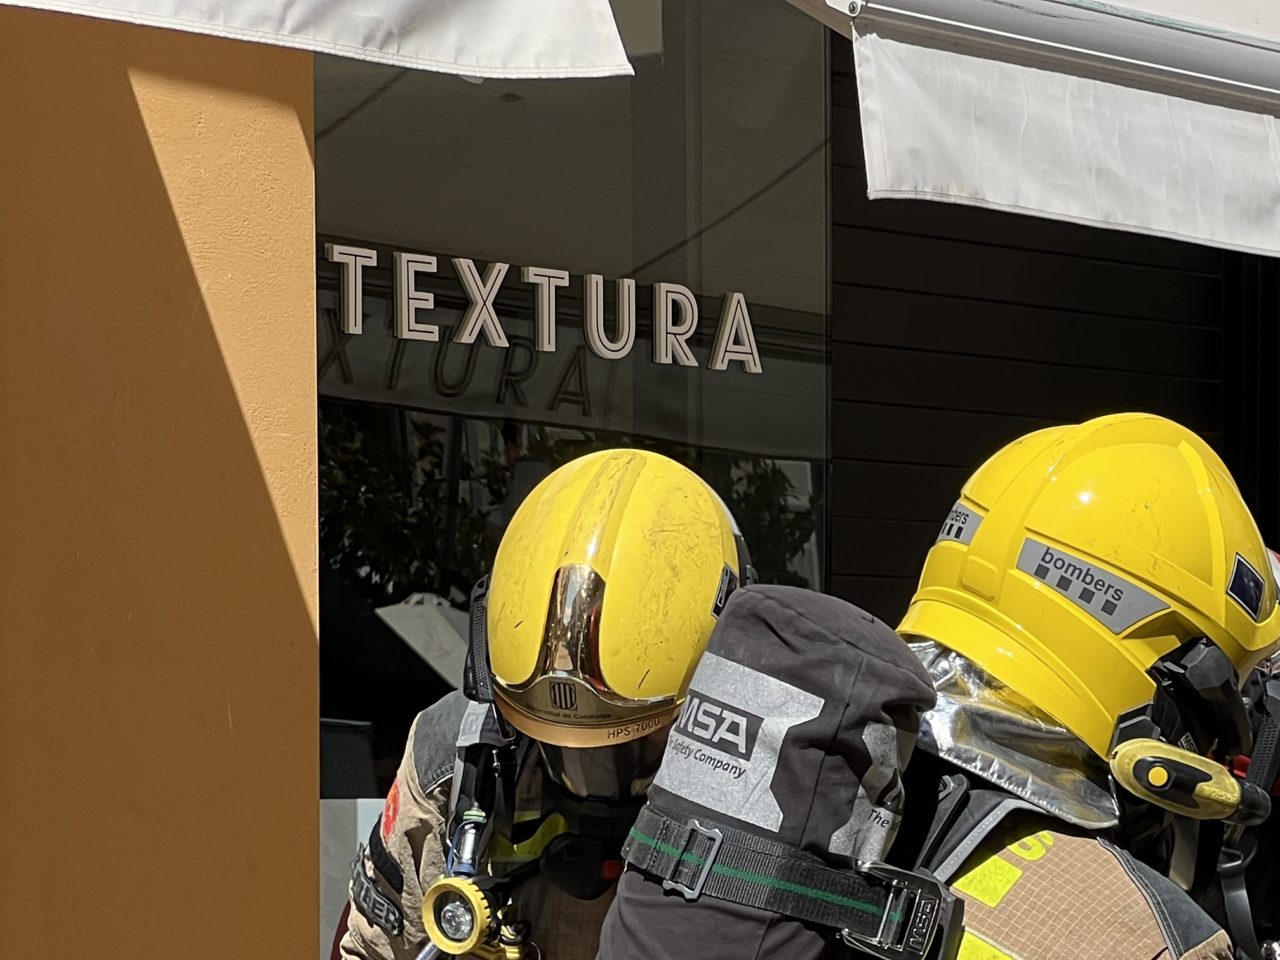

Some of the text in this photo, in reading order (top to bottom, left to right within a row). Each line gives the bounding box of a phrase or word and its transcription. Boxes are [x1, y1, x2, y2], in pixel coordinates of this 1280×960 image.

[325, 243, 763, 374] TEXTURA
[1041, 546, 1124, 601] bombers
[607, 723, 631, 739] HPS
[677, 695, 748, 754] MSA
[693, 748, 747, 779] Company
[867, 809, 890, 828] The
[909, 900, 933, 948] MSA
